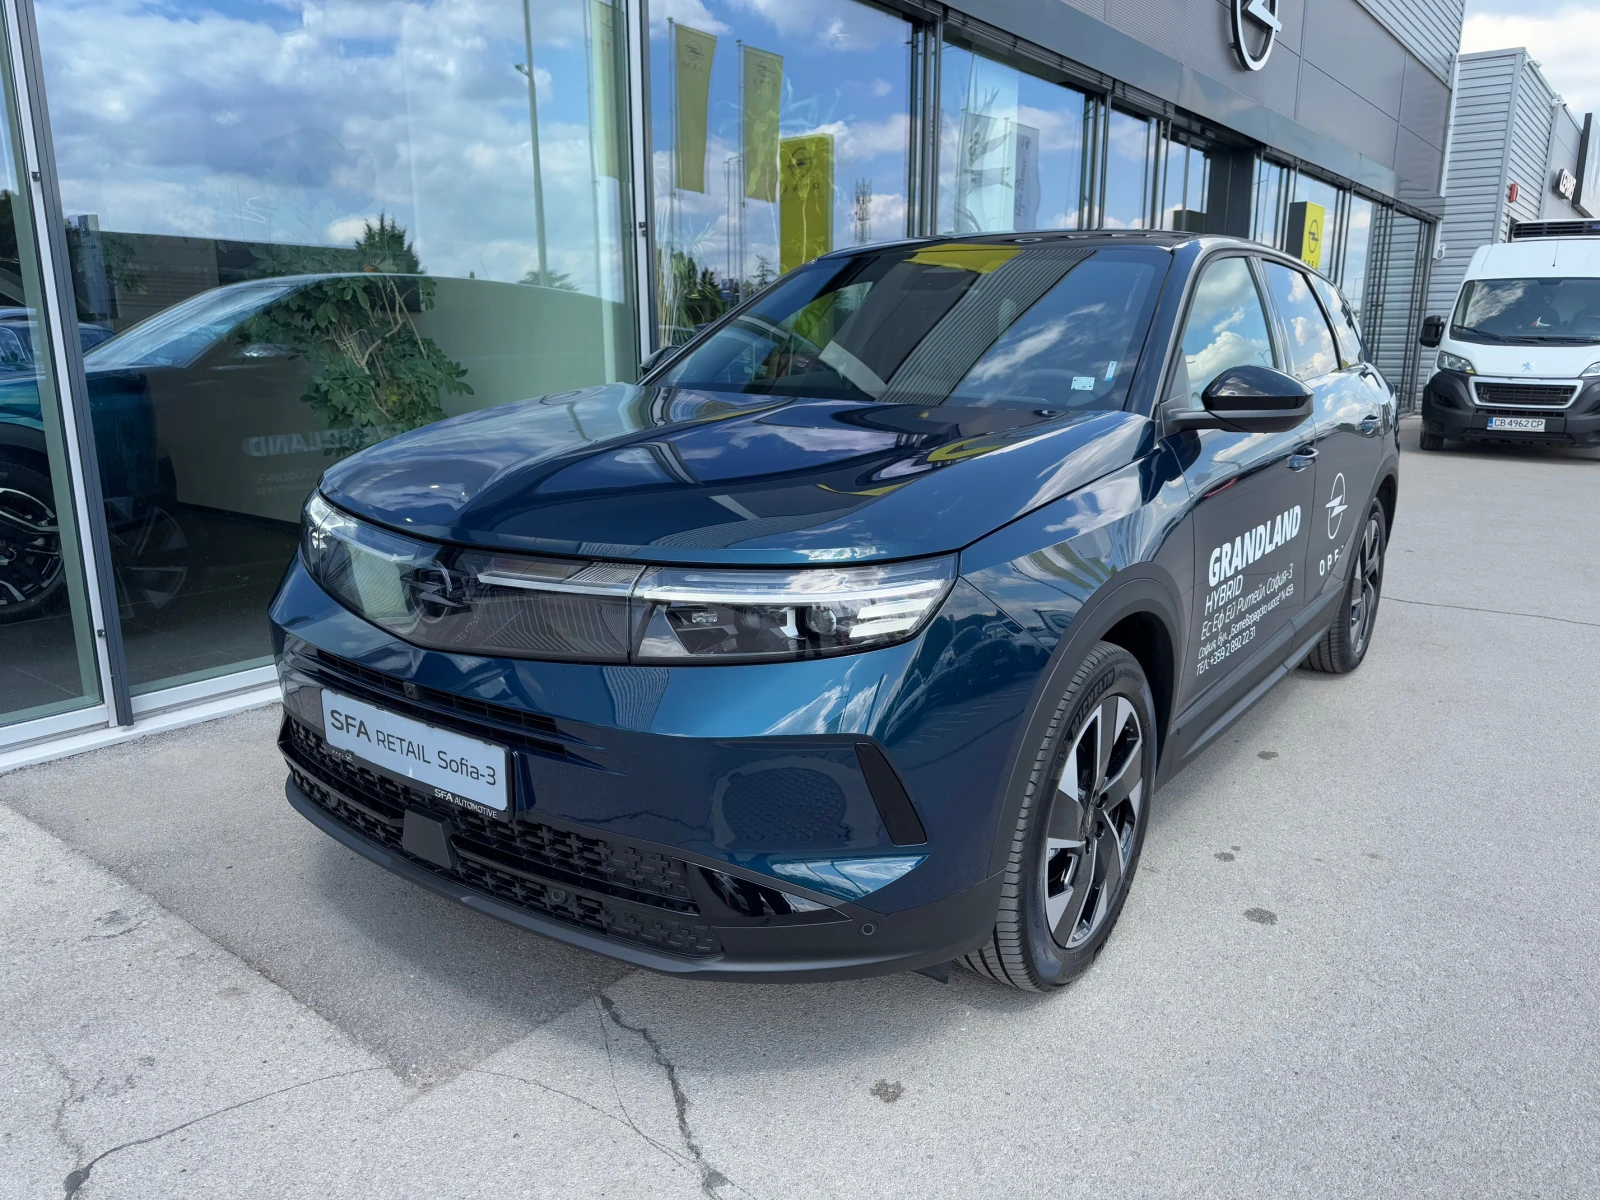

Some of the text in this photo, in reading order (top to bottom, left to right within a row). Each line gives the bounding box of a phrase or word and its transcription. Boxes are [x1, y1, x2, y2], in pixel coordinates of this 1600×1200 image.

[1494, 418, 1544, 428] CB 4962 CP
[1208, 504, 1302, 587] GRANDLAND
[1319, 544, 1344, 577] OPE
[1204, 575, 1244, 616] HYBRID
[1210, 646, 1226, 665] +359
[1226, 643, 1231, 657] 2
[1230, 635, 1242, 653] 892
[1242, 630, 1250, 645] 22
[1249, 626, 1256, 640] 31
[1070, 670, 1115, 737] MICHELIN
[330, 709, 497, 786] SFA RETAIL Sofia-3
[434, 788, 498, 819] SFA AUTOMOTIVE
